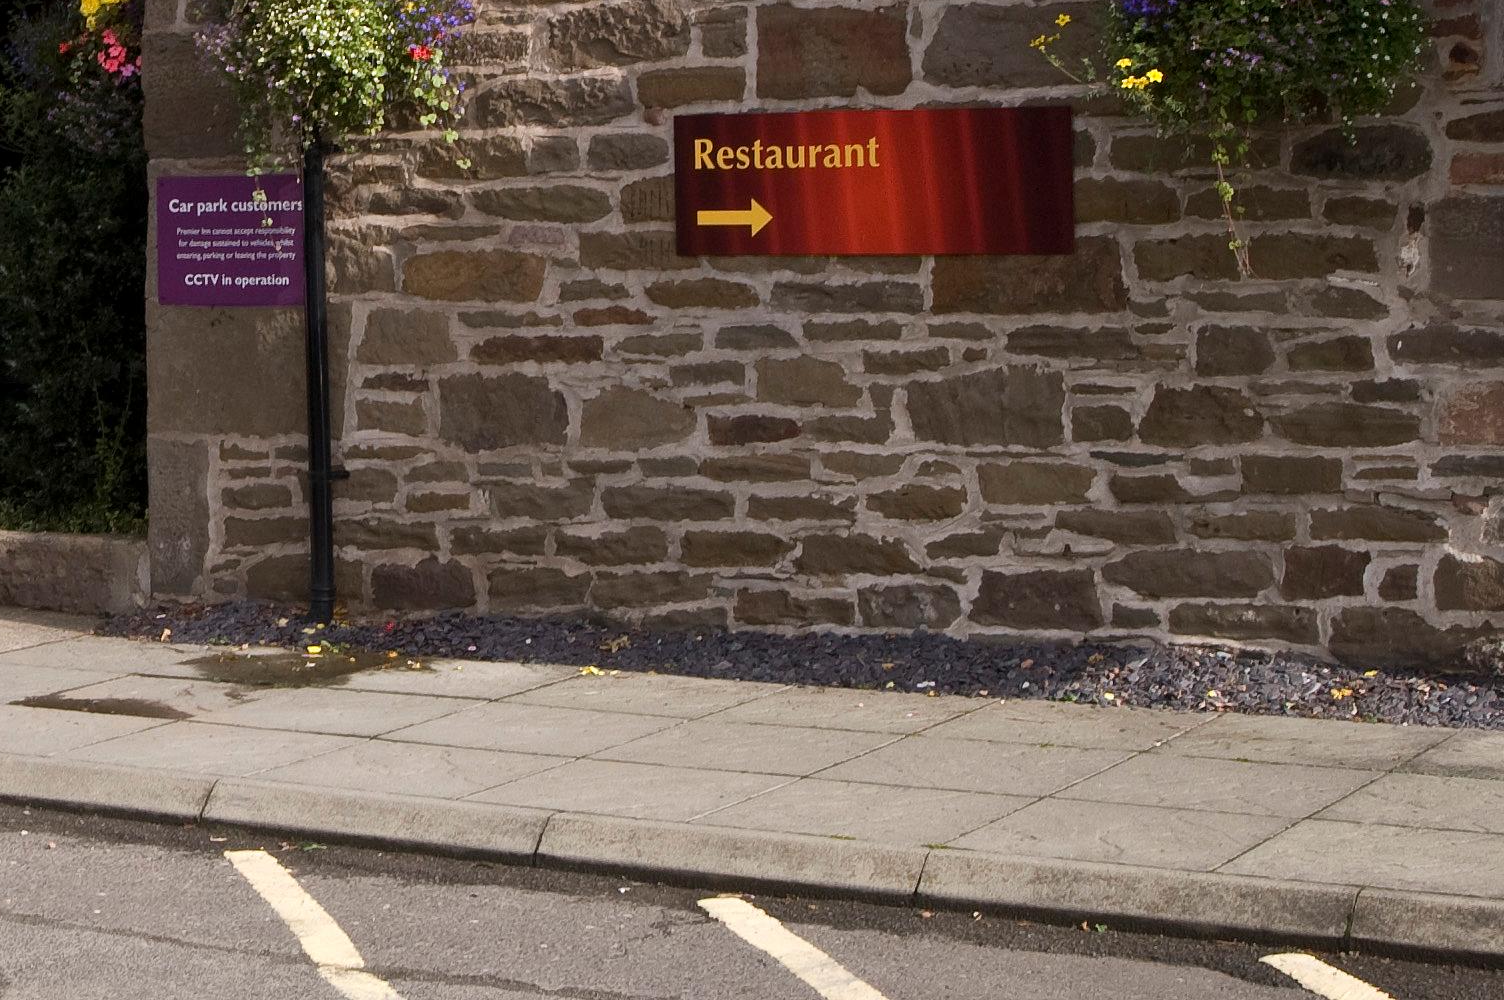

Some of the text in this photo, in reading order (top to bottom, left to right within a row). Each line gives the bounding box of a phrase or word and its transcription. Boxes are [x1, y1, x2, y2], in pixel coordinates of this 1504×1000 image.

[694, 136, 881, 171] Restaurant
[168, 198, 303, 217] Car park customers
[184, 274, 290, 289] CCTV in operation
